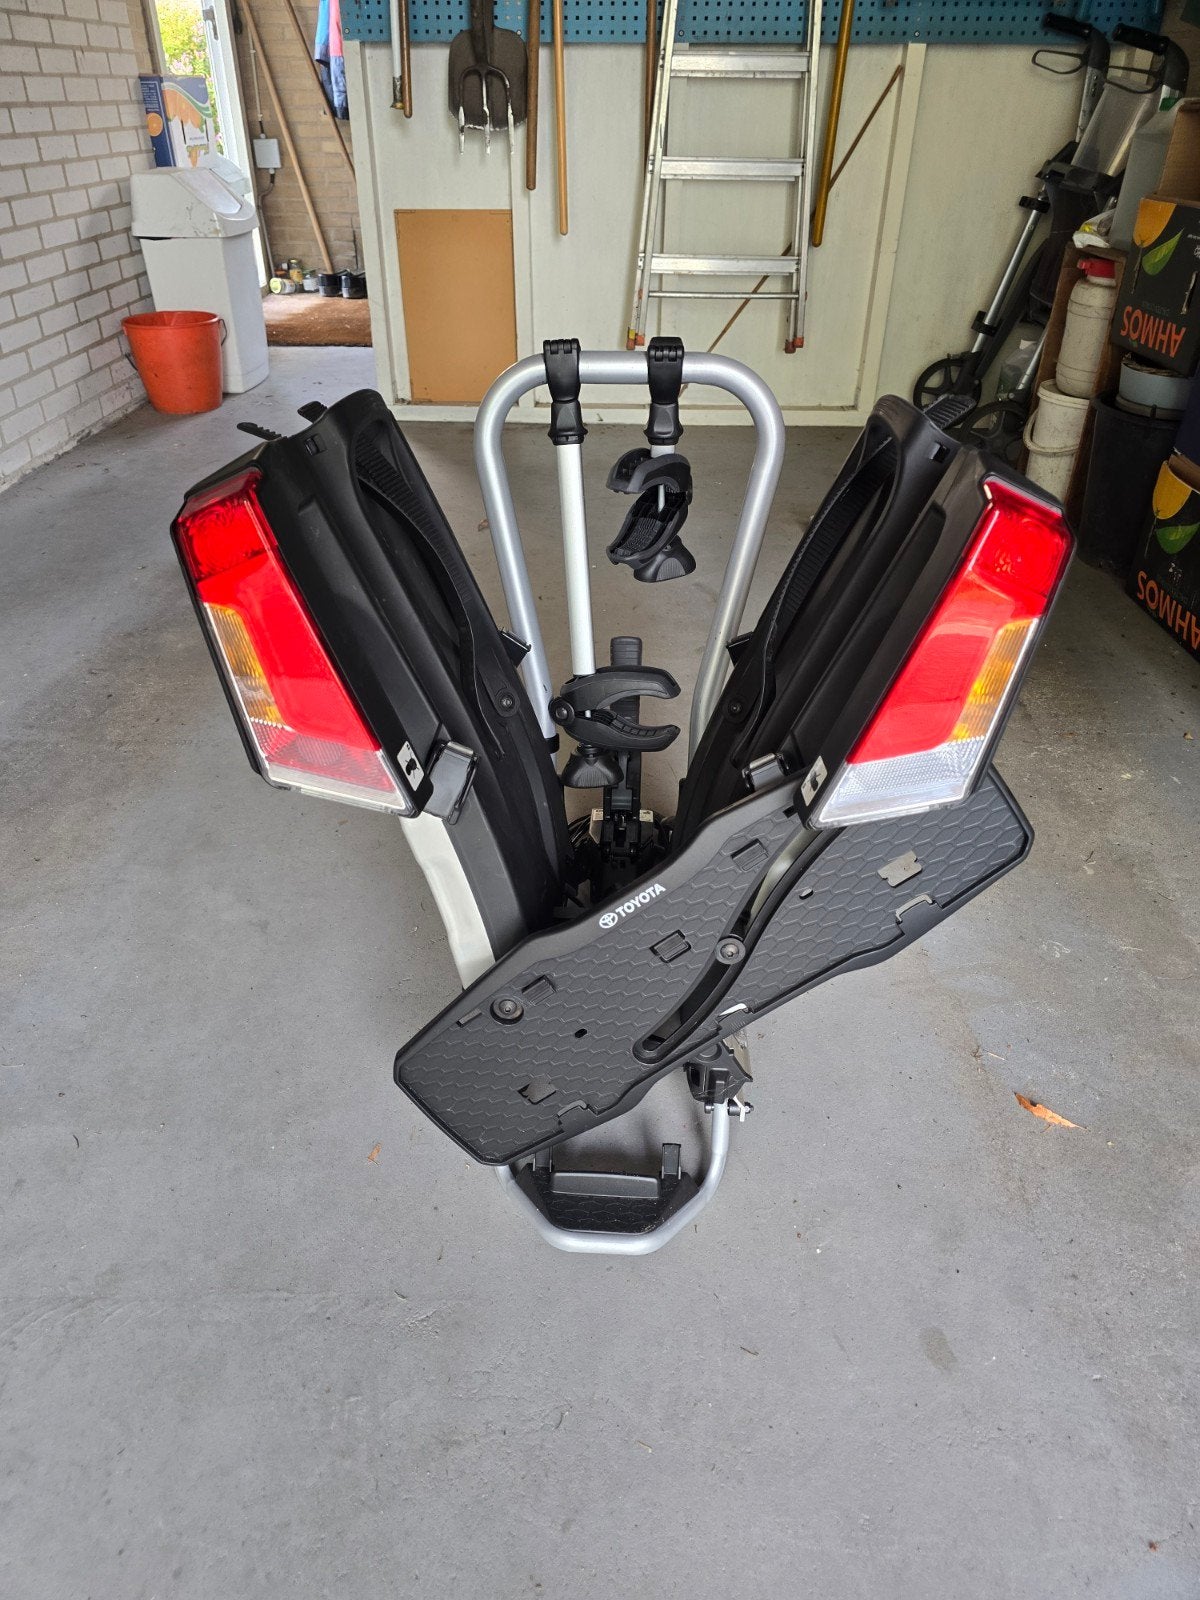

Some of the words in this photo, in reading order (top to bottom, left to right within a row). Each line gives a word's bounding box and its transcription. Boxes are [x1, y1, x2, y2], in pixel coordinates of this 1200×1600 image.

[1120, 306, 1187, 358] AHMOS
[1137, 571, 1200, 649] AHMOS
[615, 883, 667, 917] TOYOTA
